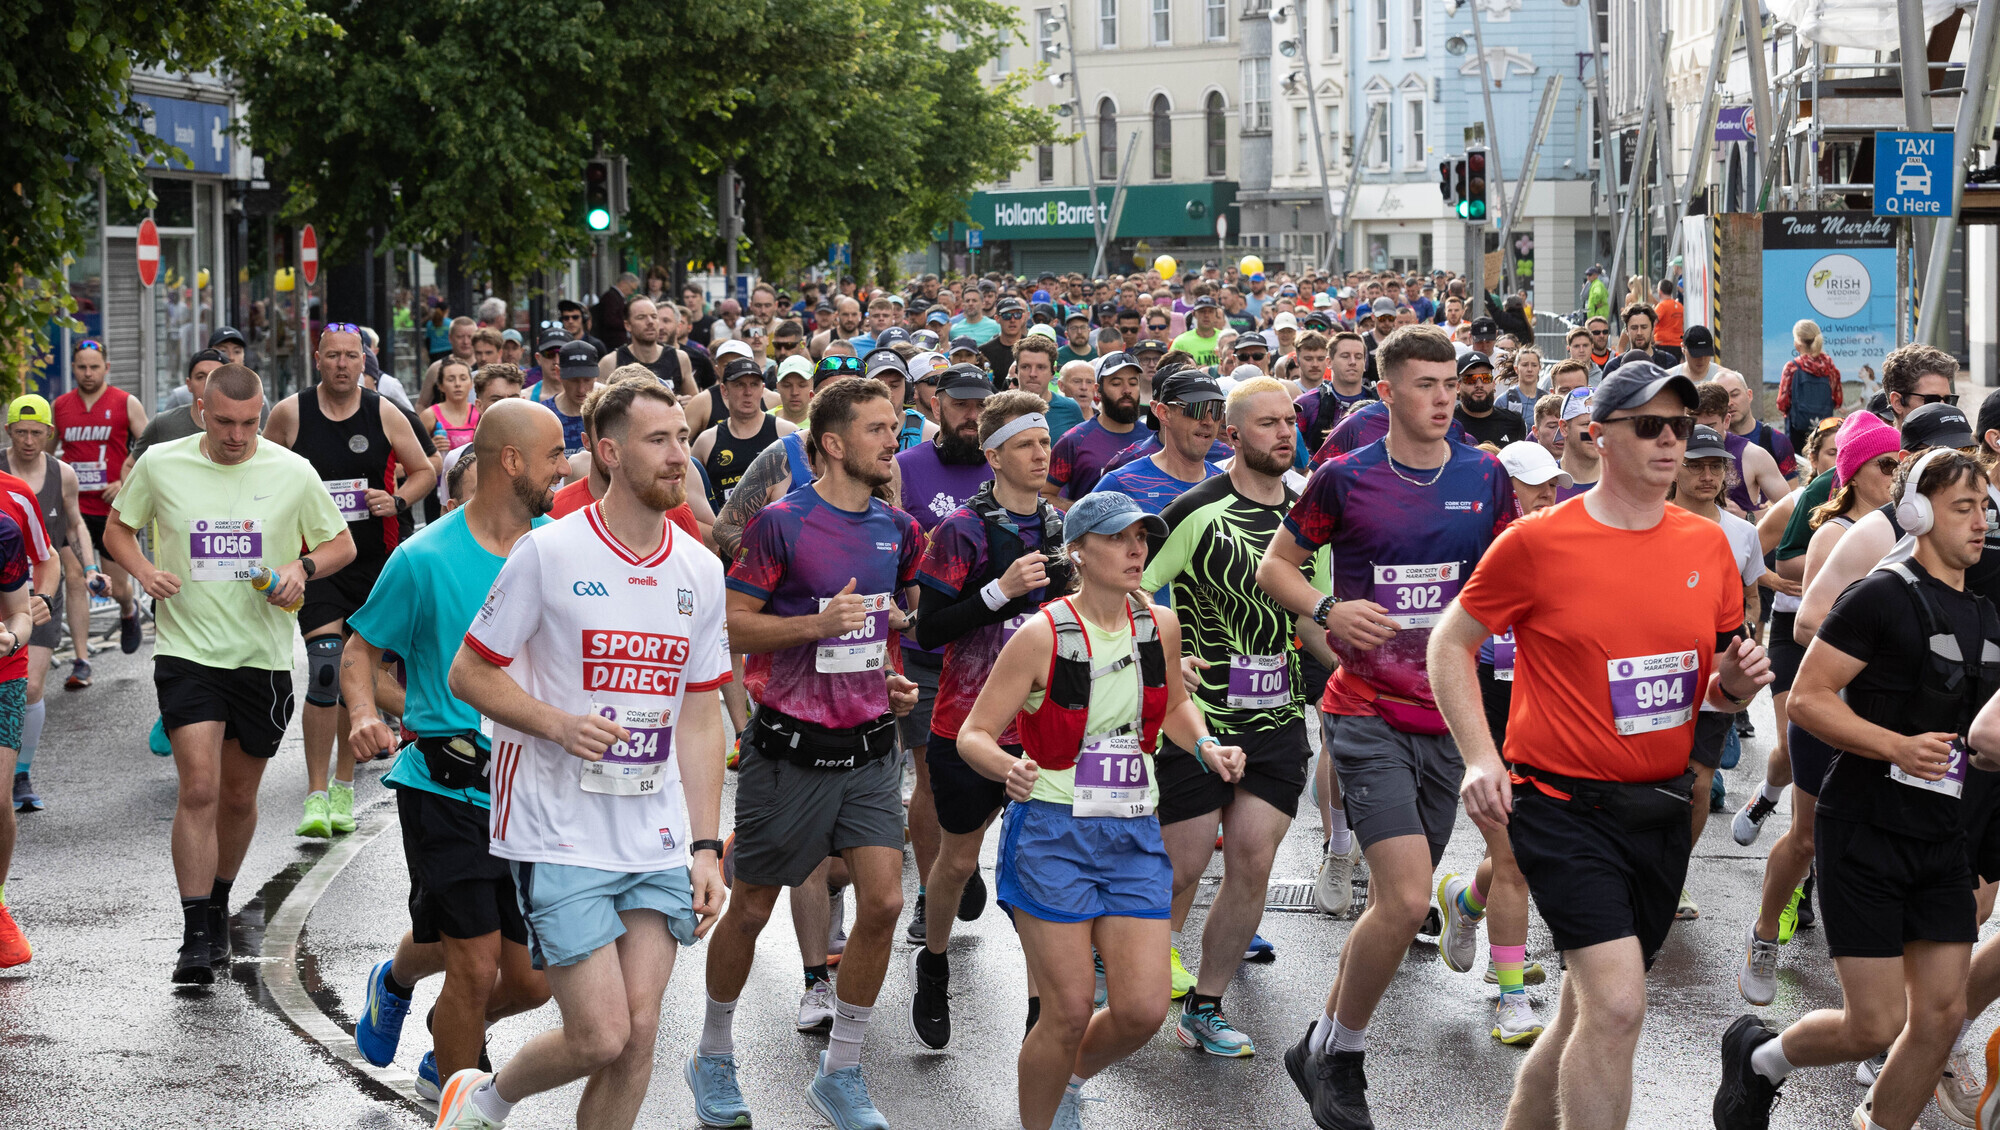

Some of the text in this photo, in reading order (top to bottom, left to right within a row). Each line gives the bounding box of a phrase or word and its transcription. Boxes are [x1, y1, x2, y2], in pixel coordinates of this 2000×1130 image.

[1895, 138, 1935, 156] TAXI
[1885, 197, 1940, 214] Q Here
[1782, 215, 1892, 238] Tom Murphy
[1826, 279, 1861, 290] IRISH
[1835, 324, 1869, 333] Winner
[1823, 336, 1876, 346] Supplier of
[1832, 348, 1858, 356] Wear
[1861, 347, 1885, 357] 2023
[64, 425, 113, 442] MIAMI
[330, 493, 356, 510] 98
[1097, 494, 1121, 515] NEW
[201, 535, 252, 555] 1056
[234, 570, 252, 579] 105
[572, 580, 610, 598] GAA
[1396, 585, 1442, 610] 302
[590, 633, 689, 663] SPORTS
[865, 657, 880, 668] 808
[1643, 662, 1679, 671] MARATHON
[1664, 655, 1680, 663] CITY
[591, 666, 681, 694] DIRECT
[1249, 671, 1283, 693] 100
[1635, 677, 1684, 709] 994
[814, 755, 855, 767] nerd
[1099, 756, 1142, 783] 119
[640, 779, 654, 792] 834
[1130, 804, 1144, 815] 119
